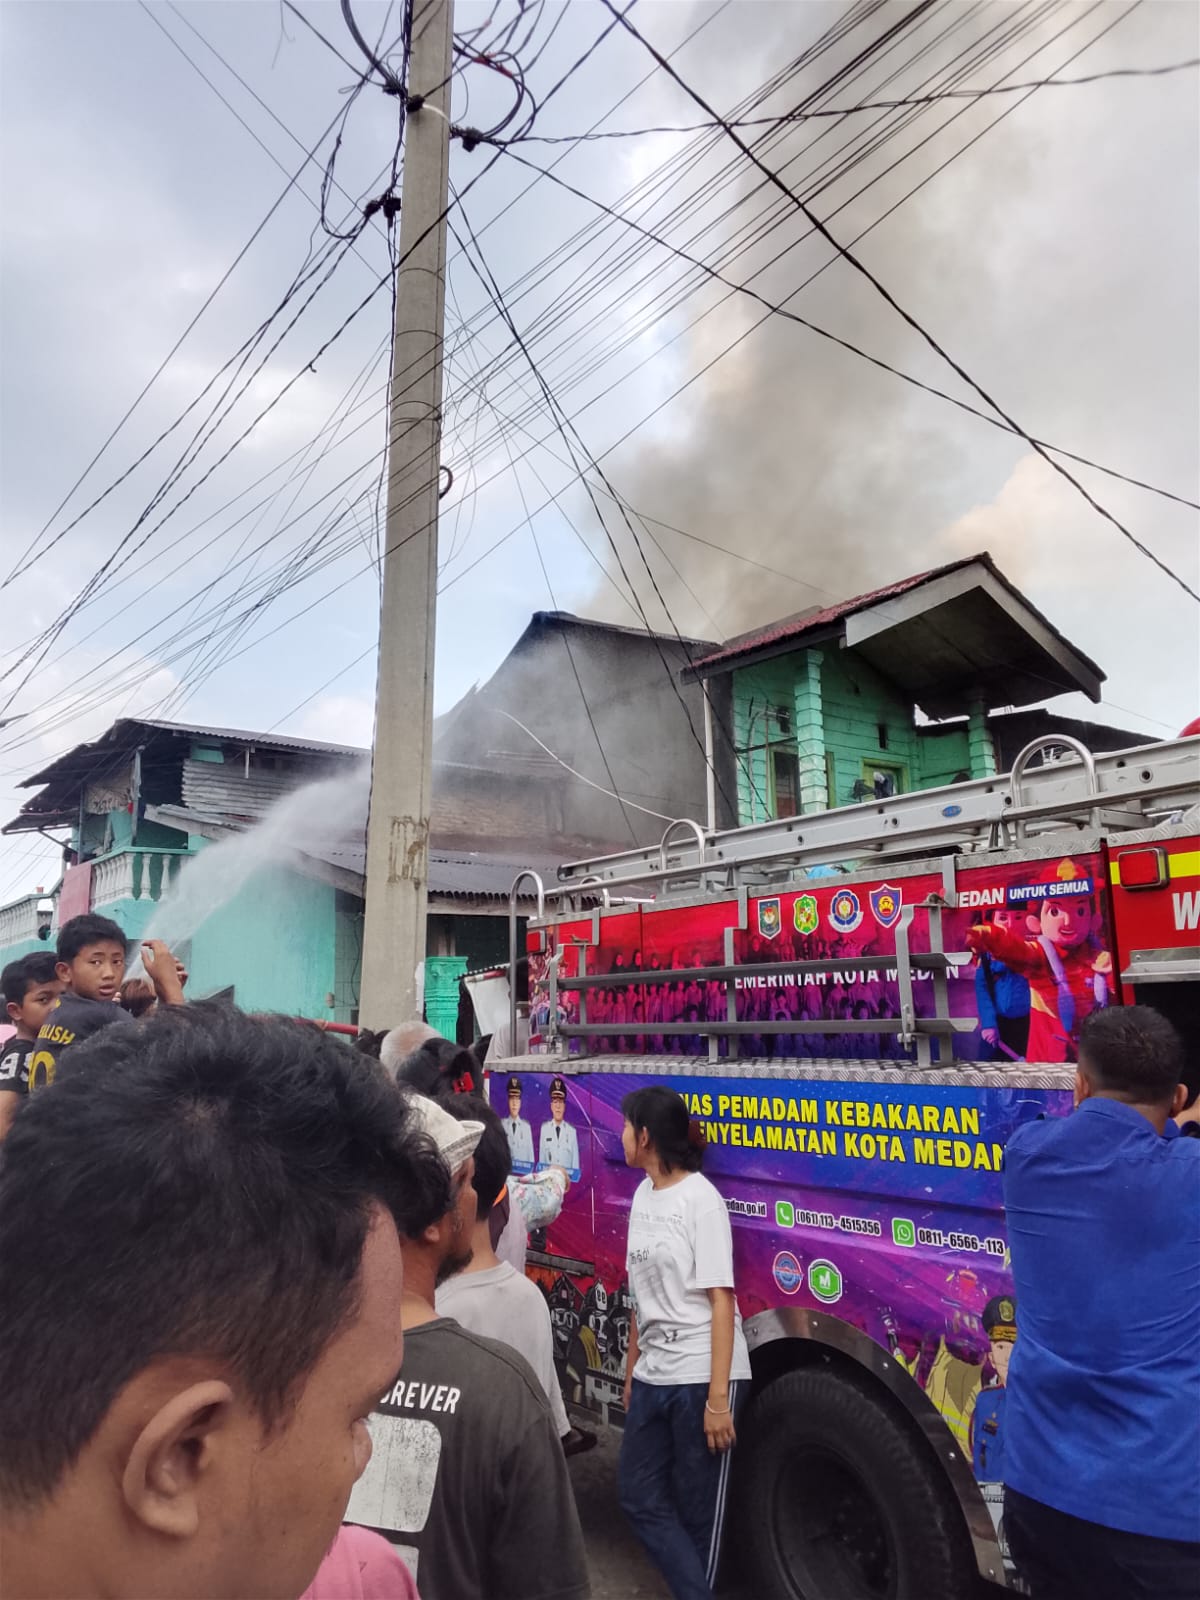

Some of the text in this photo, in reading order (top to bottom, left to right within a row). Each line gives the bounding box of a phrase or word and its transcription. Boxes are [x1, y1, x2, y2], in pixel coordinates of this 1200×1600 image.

[958, 881, 1089, 908] EDAN UNTUK SEMUA
[724, 972, 826, 990] EMERINTAH
[718, 1095, 819, 1124] PEMADAM
[826, 1100, 980, 1135] KEBAKARAN
[844, 1132, 906, 1162] KOTA
